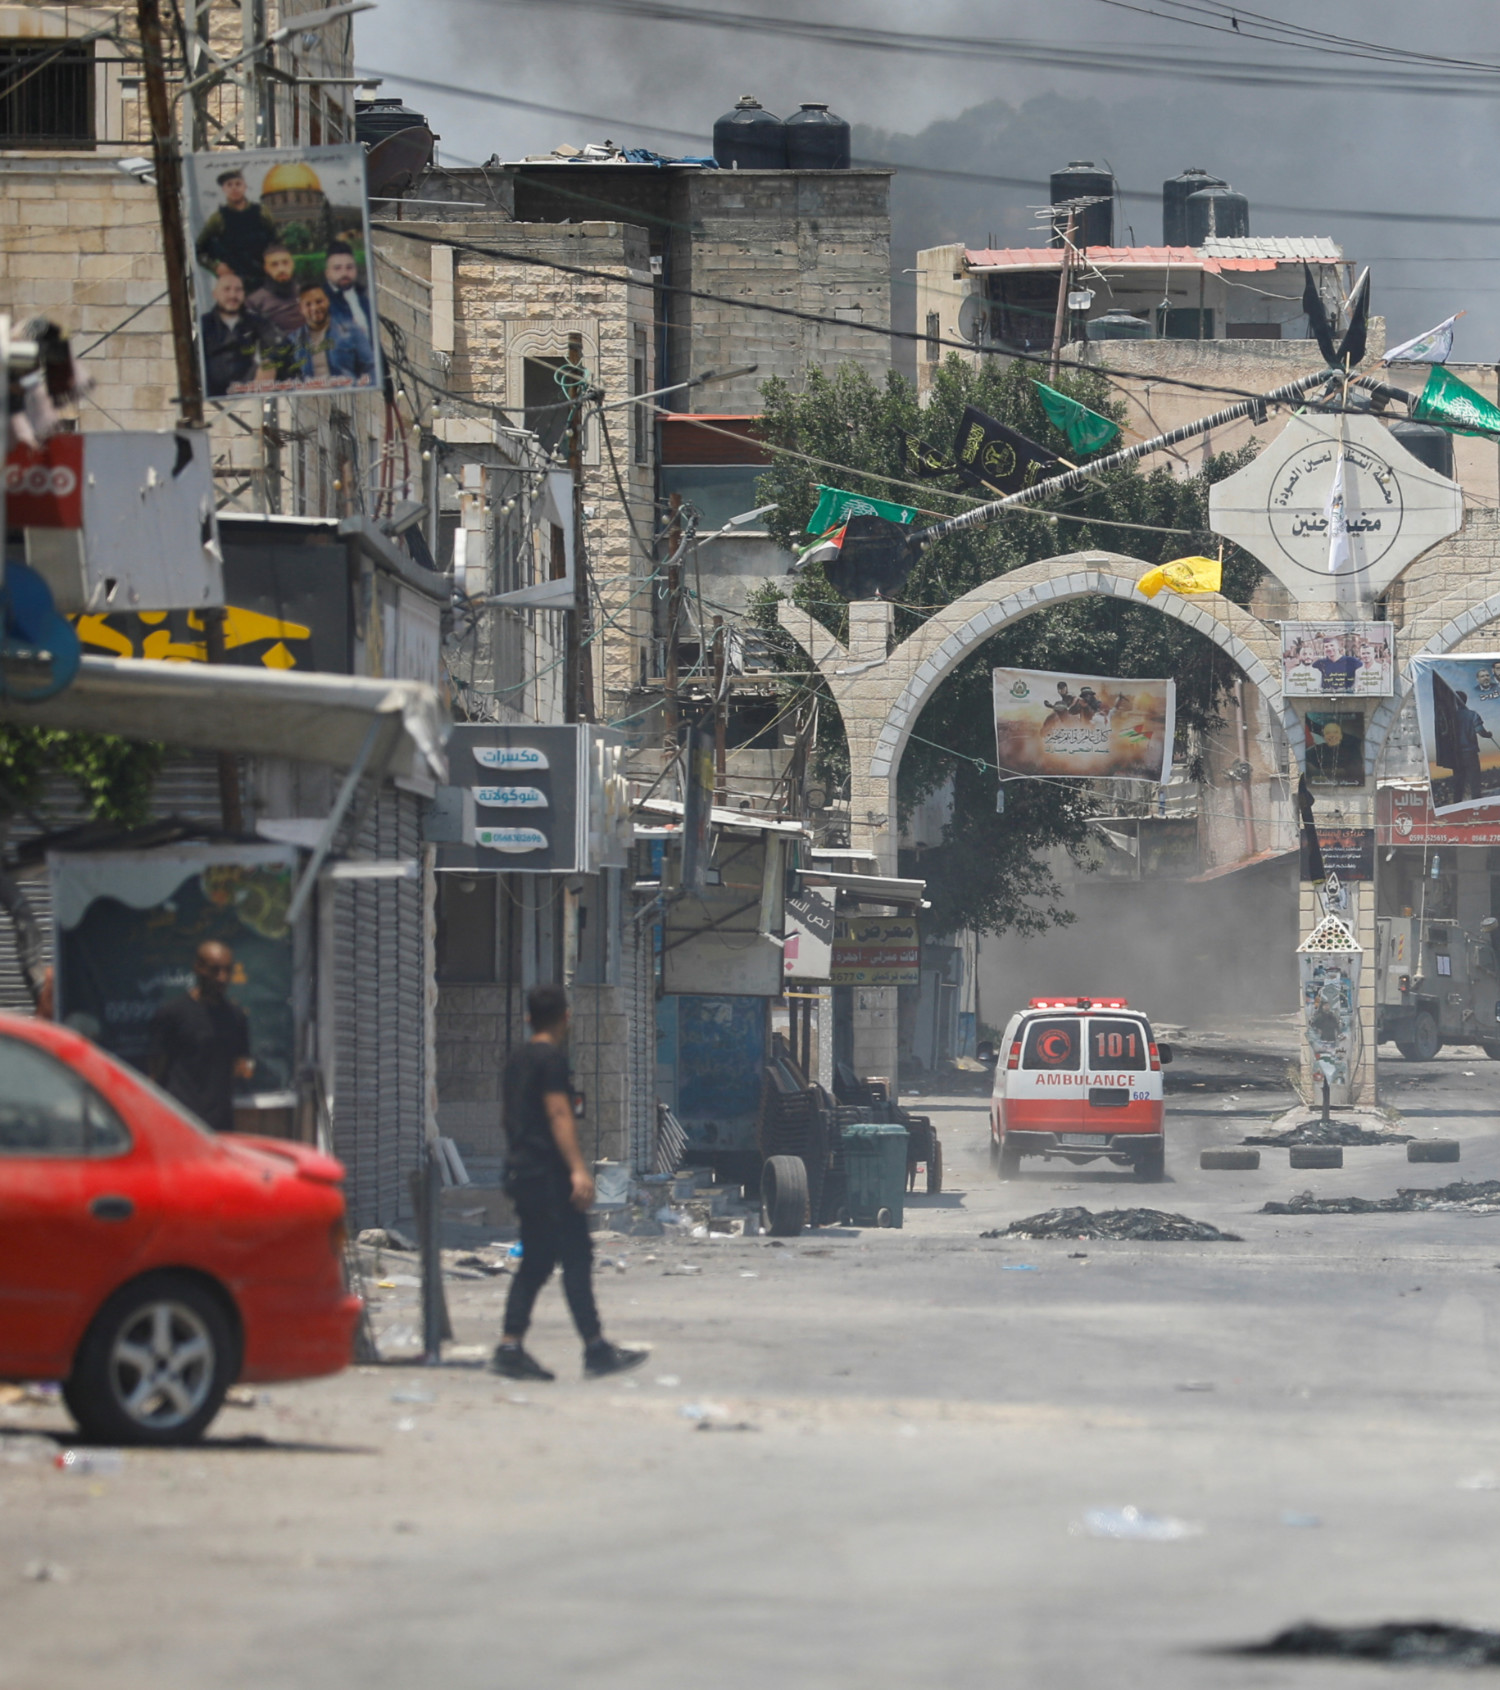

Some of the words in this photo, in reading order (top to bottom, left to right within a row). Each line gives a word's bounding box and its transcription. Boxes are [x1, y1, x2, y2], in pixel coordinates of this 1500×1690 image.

[1274, 466, 1303, 506] العودة
[482, 750, 539, 766] مكسرات
[479, 788, 539, 804] شوكولاتة
[1095, 1032, 1136, 1057] 101
[1035, 1073, 1136, 1087] AMBULANCE
[1132, 1091, 1151, 1101] 602
